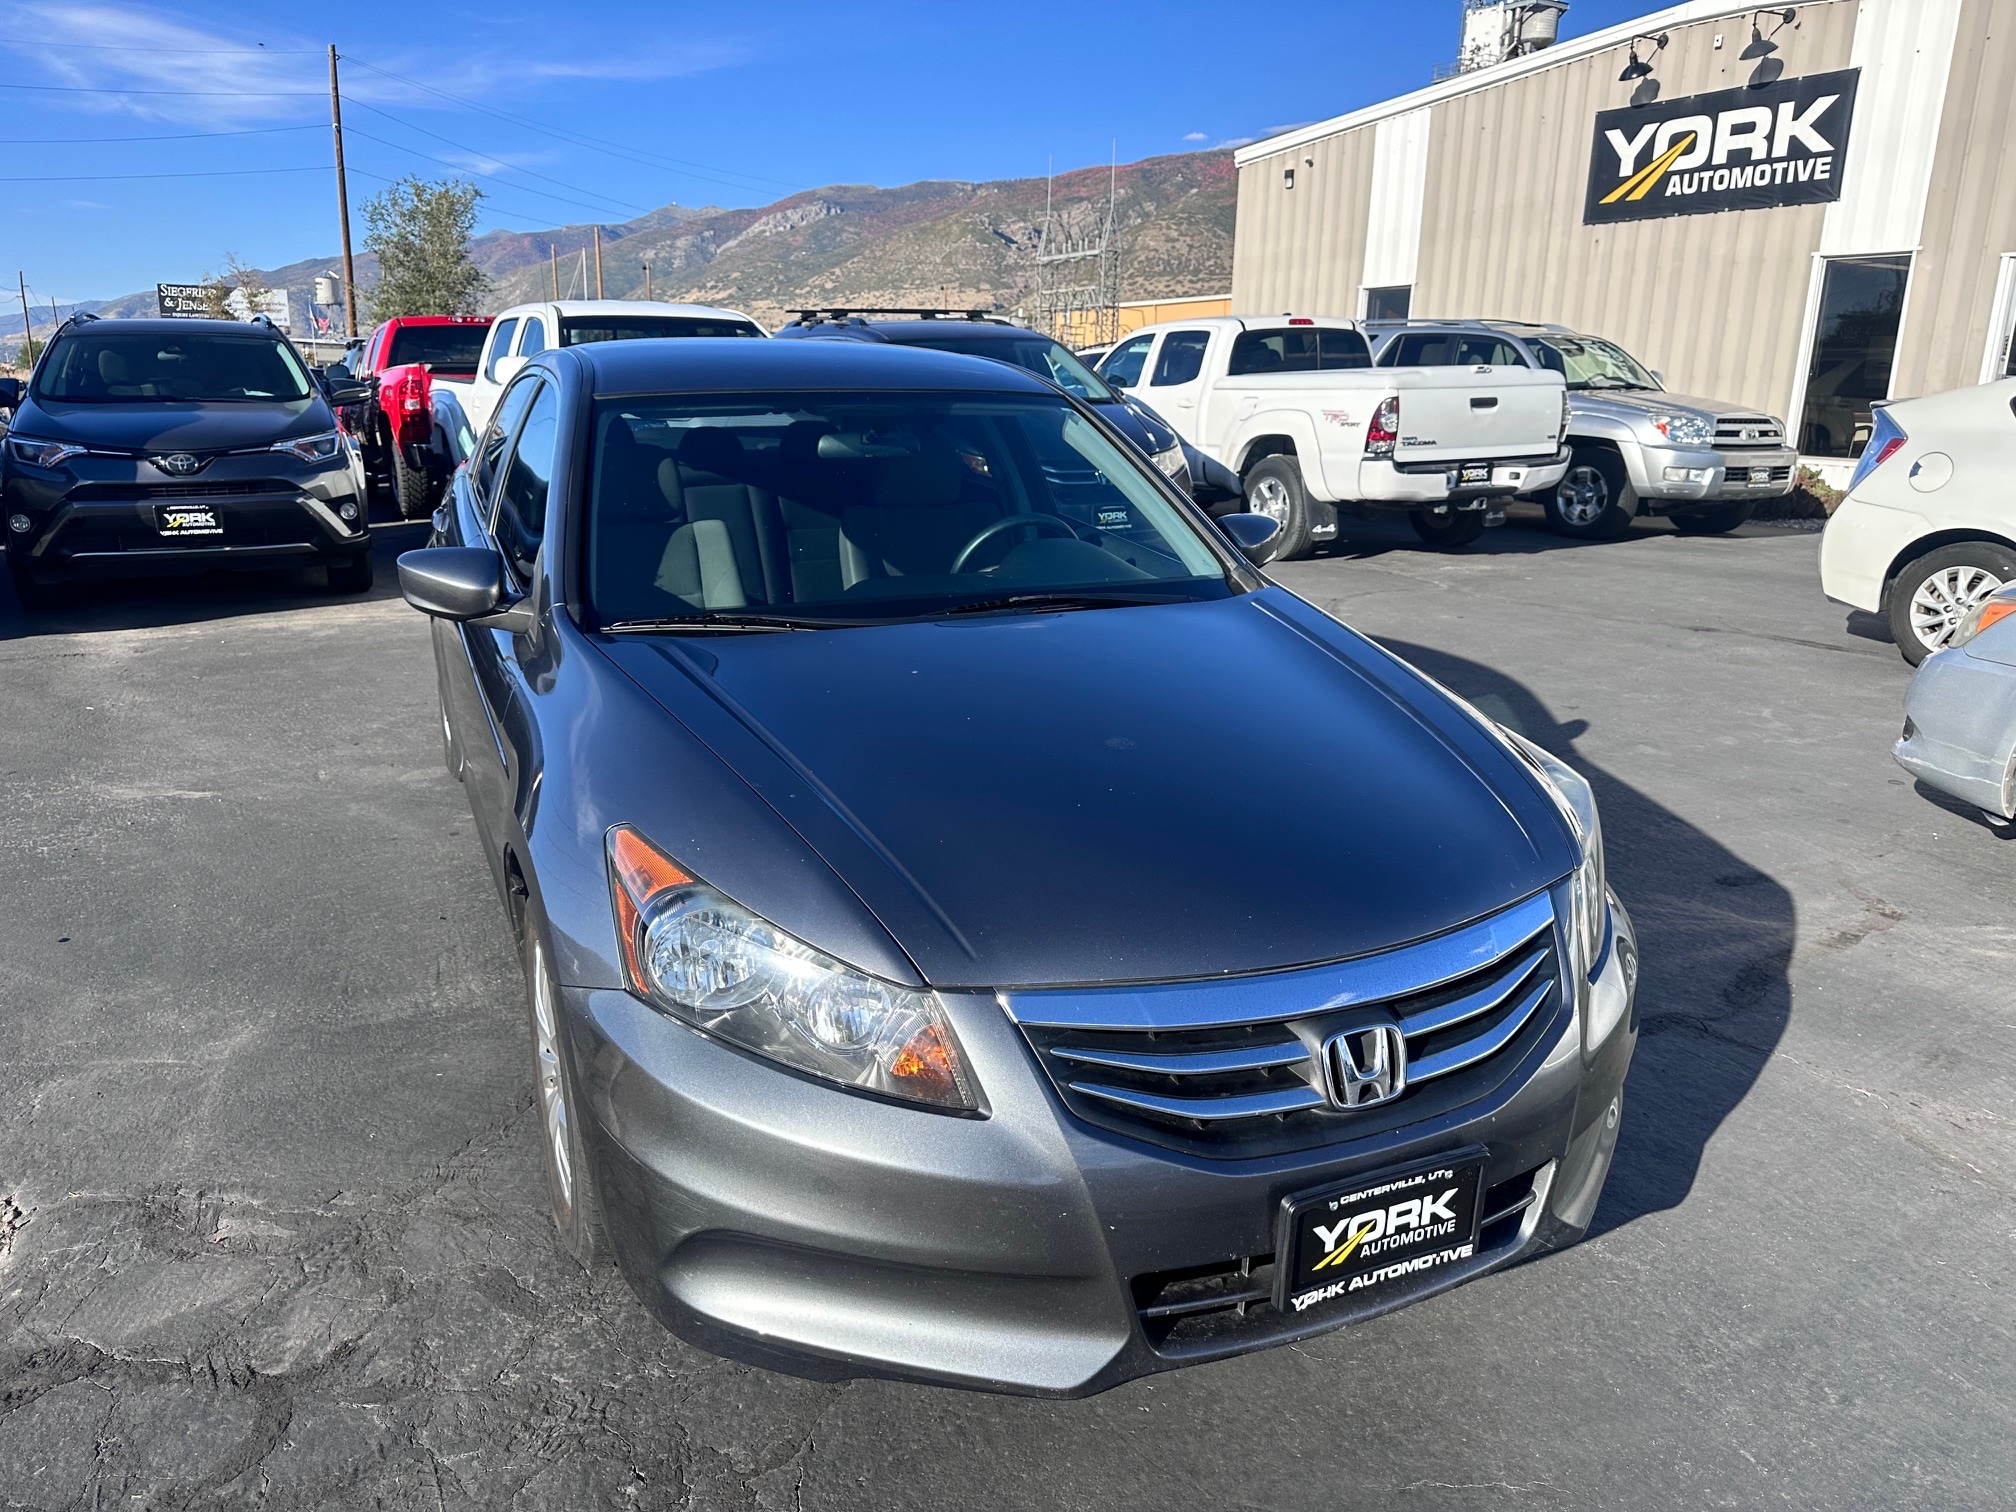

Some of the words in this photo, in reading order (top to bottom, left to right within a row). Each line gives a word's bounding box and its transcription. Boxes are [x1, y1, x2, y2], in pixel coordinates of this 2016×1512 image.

[1604, 94, 1841, 177] YORK
[1664, 156, 1832, 197] AUTOMOTIVE
[160, 284, 217, 297] SIEGFRID
[164, 297, 175, 307] &
[176, 298, 210, 311] JENSE
[1462, 468, 1489, 478] YORK
[163, 512, 216, 523] YORK
[1097, 511, 1128, 520] YORK
[1340, 1175, 1426, 1205] CENTERVILLE,
[1312, 1187, 1459, 1254] YORK
[1360, 1219, 1456, 1258] AUTOMOTIVE
[1348, 1243, 1474, 1292] AUTOMOTIVE
